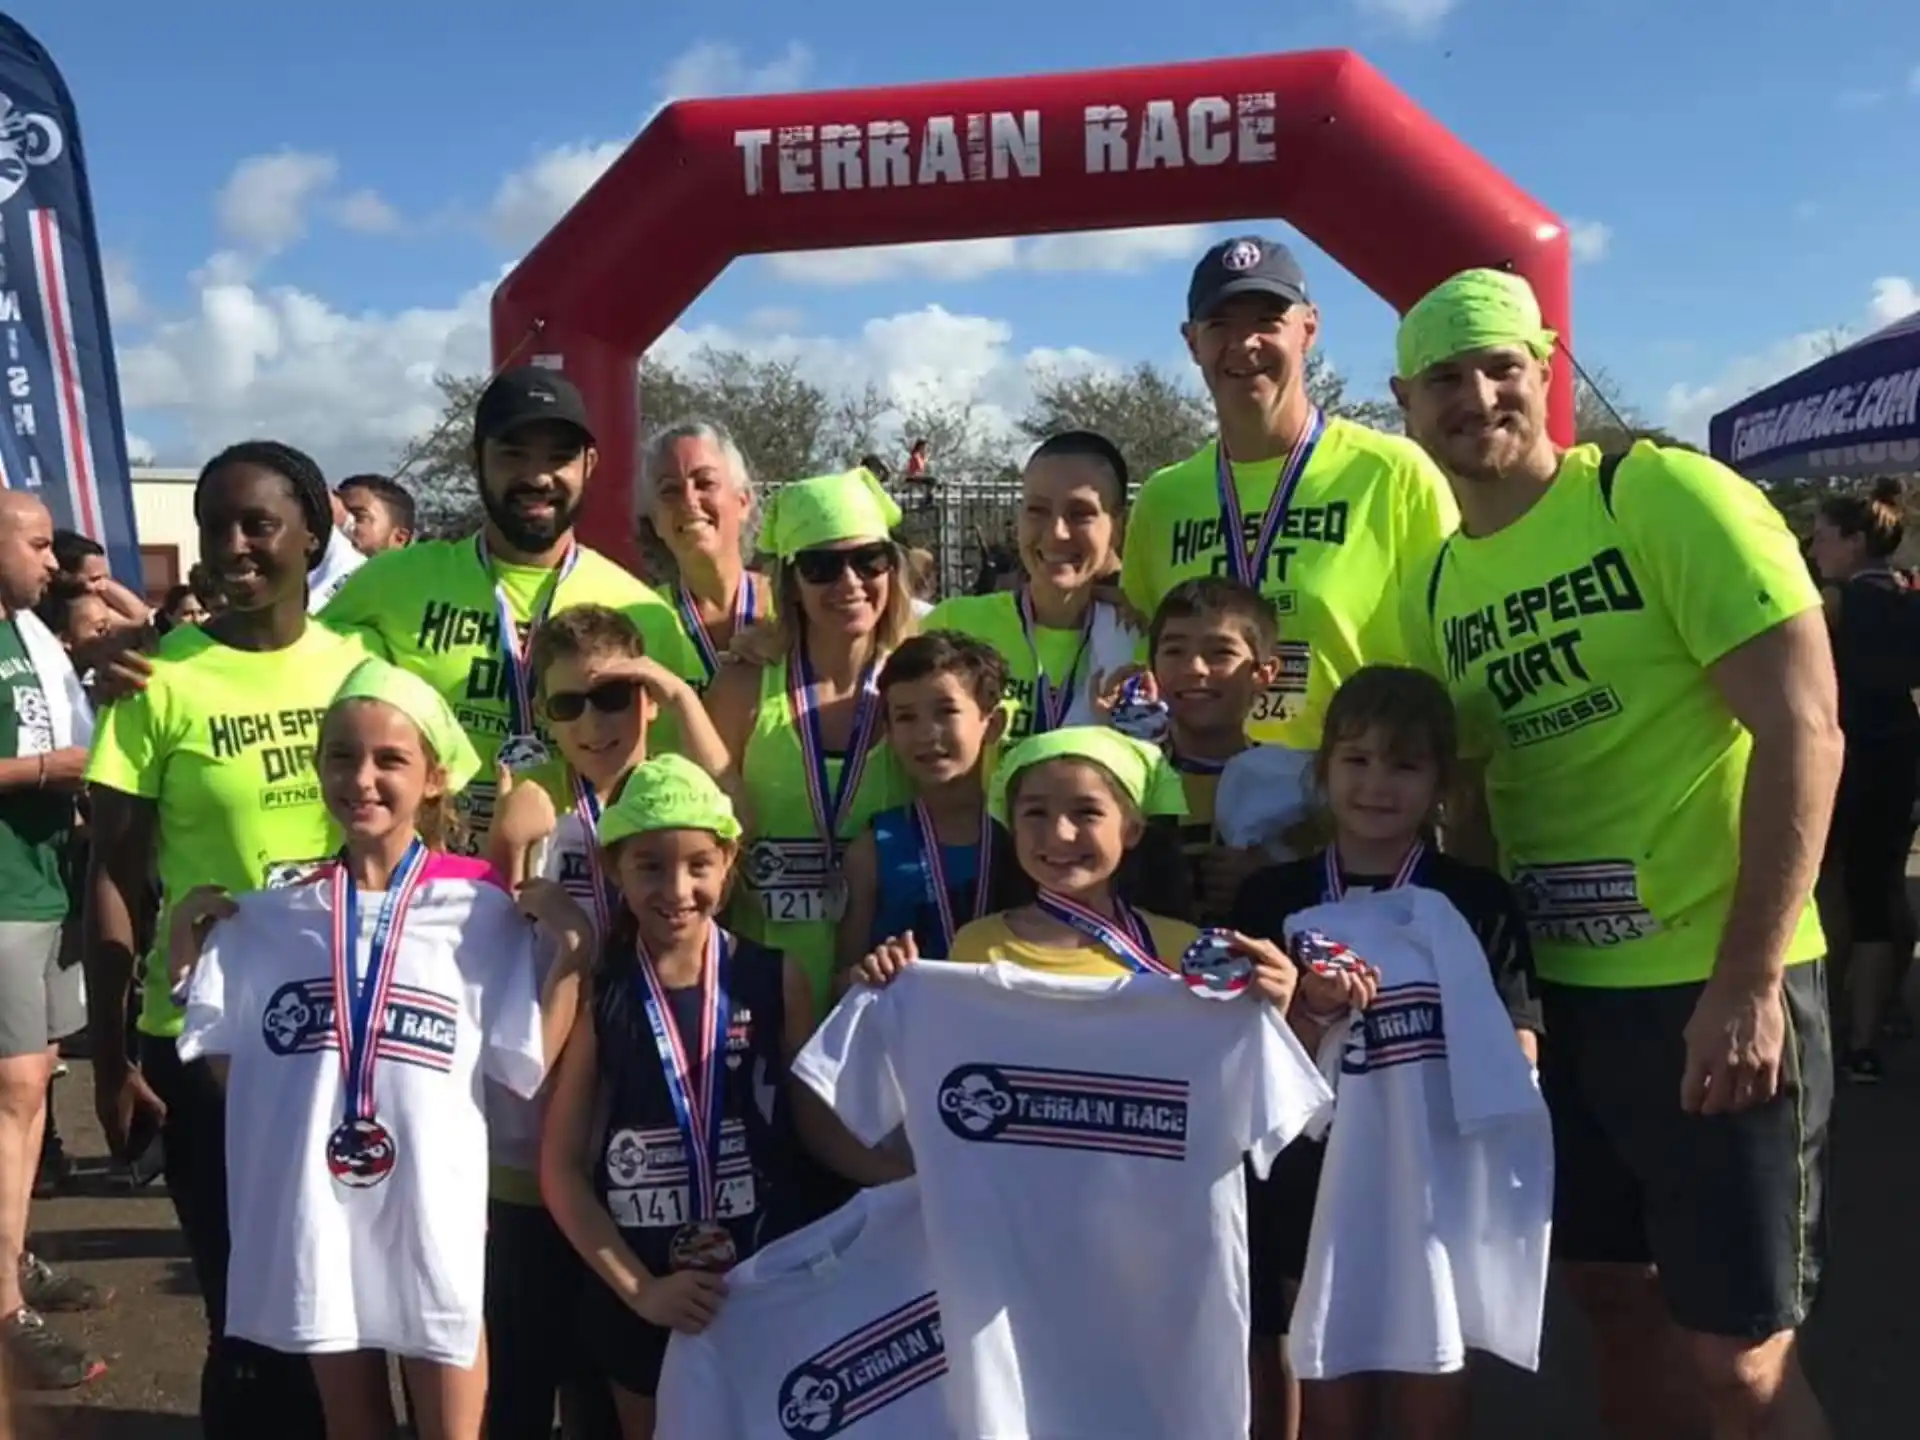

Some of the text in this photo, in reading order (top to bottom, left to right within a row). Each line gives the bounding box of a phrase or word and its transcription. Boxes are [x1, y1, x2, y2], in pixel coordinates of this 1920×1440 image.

[734, 92, 1277, 197] TERRAIN RACE
[1244, 501, 1349, 546] SEED
[417, 599, 501, 654] HIGH
[1443, 547, 1645, 685] HIGH SPEED
[1486, 628, 1591, 712] DIRT
[208, 706, 329, 759] HIGH SPE
[1507, 690, 1614, 743] FITNESS
[261, 743, 316, 785] DIR
[264, 787, 319, 806] FITNE
[762, 890, 826, 919] 121
[401, 1011, 457, 1048] RACE
[1016, 1092, 1186, 1133] TERRAIN RACE
[628, 1181, 735, 1224] 1414
